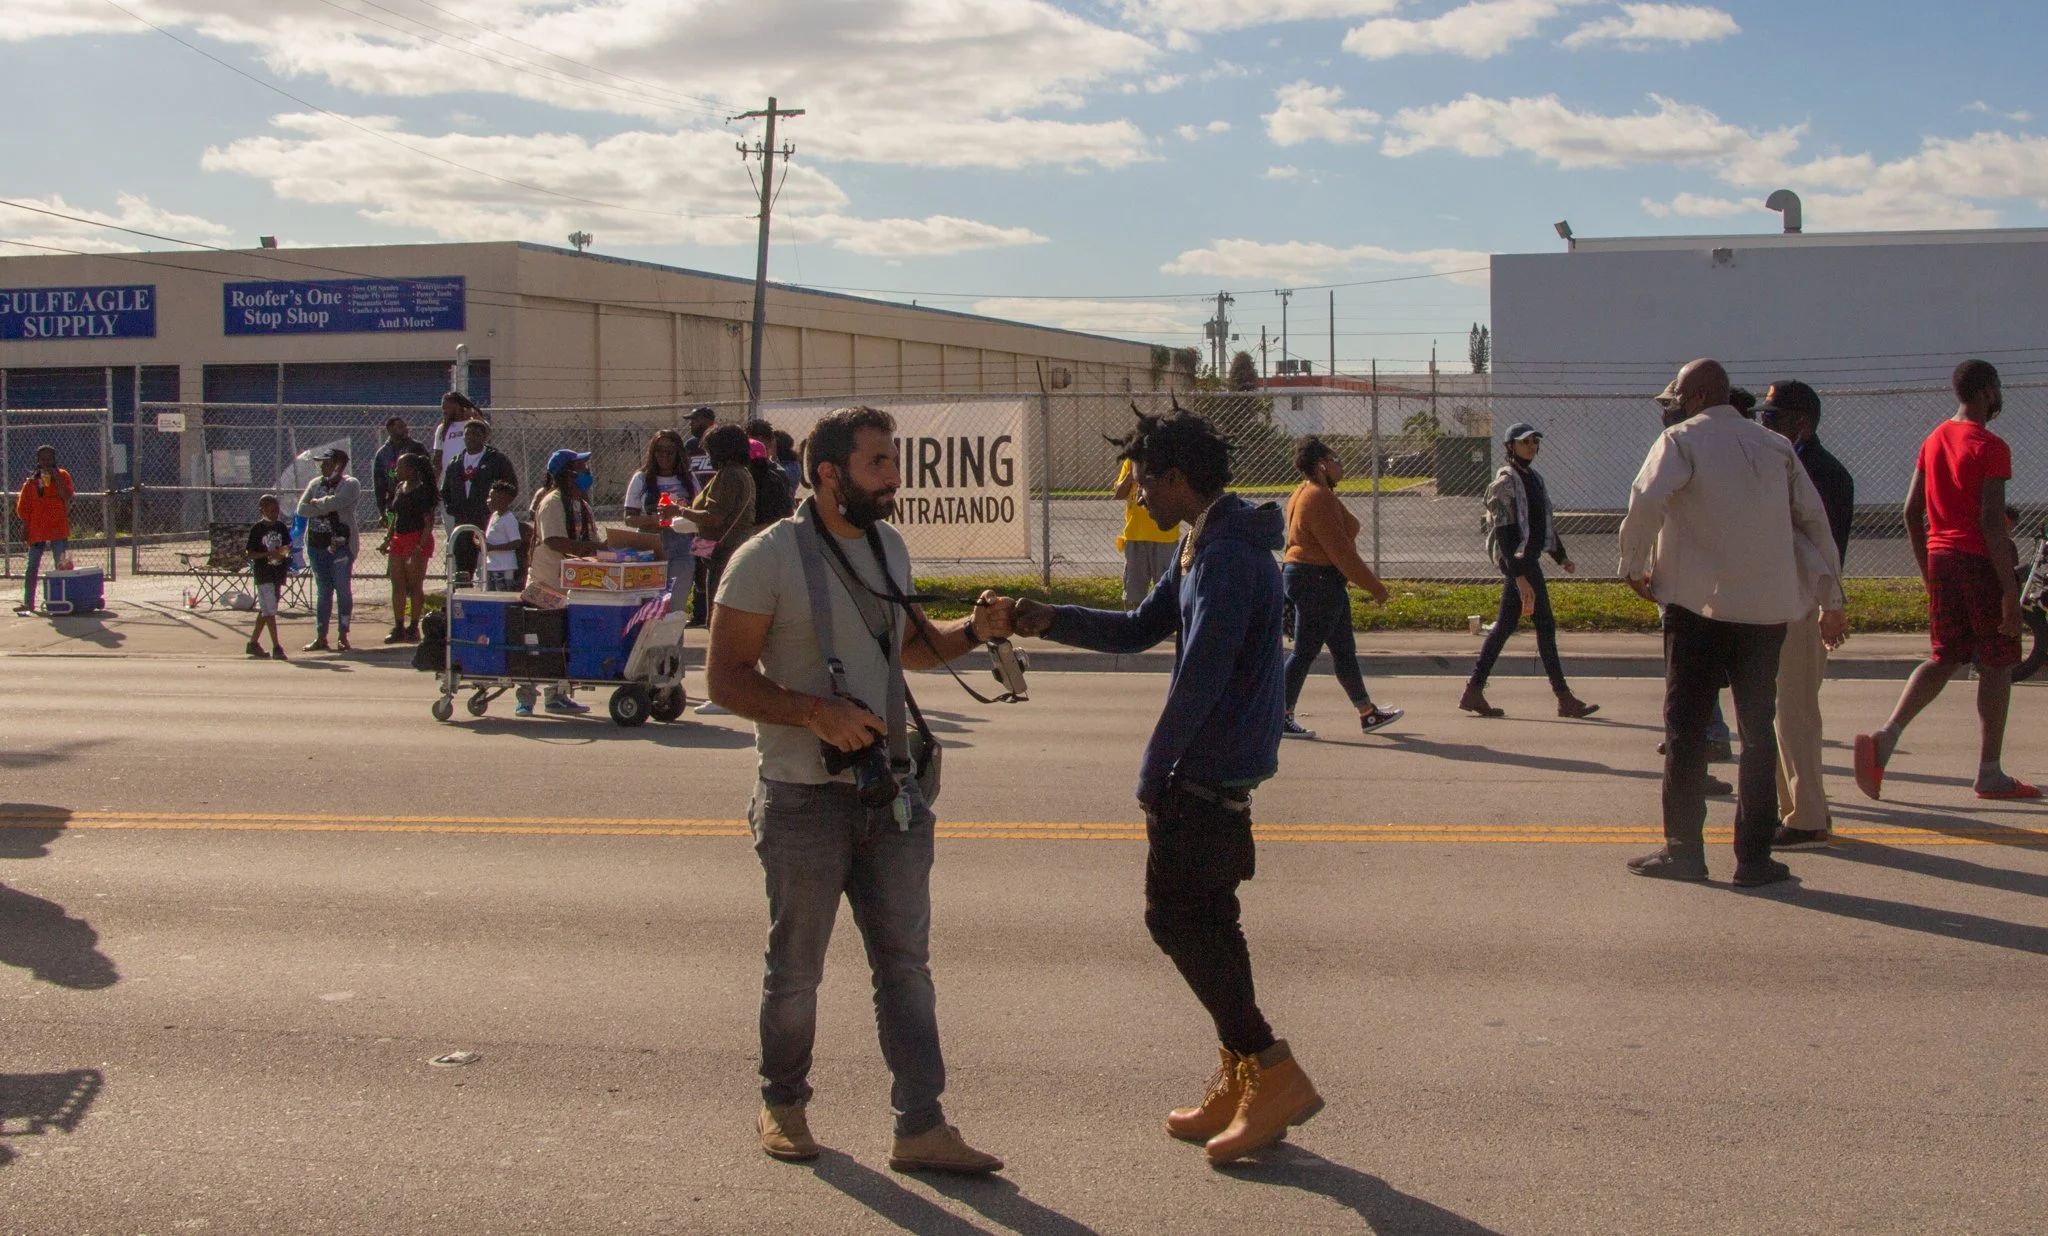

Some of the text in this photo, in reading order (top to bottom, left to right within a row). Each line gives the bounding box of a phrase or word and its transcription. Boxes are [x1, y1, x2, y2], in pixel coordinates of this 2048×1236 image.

[0, 289, 150, 314] GULFEAGLE
[231, 288, 342, 307] Roofer's One
[23, 314, 119, 338] SUPPLY
[244, 307, 330, 329] Stop Shop
[377, 315, 435, 328] And More!
[885, 495, 1015, 525] NTRATANDO
